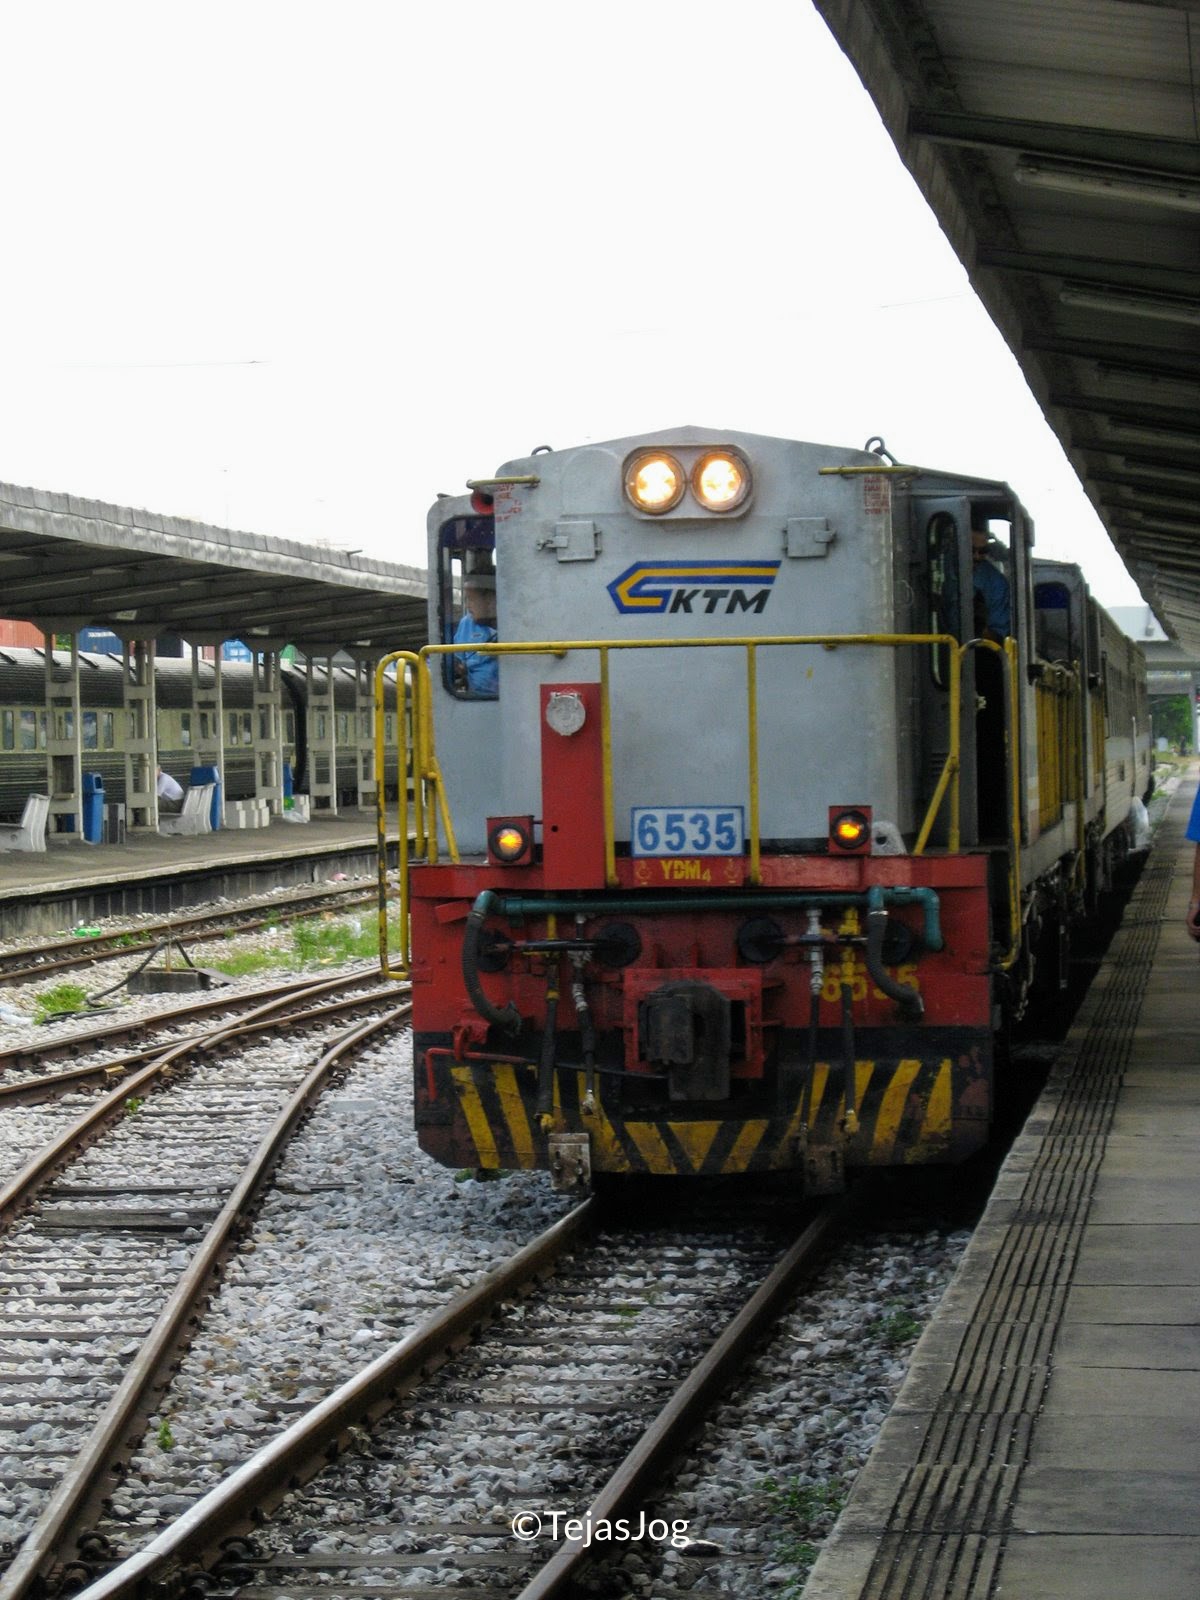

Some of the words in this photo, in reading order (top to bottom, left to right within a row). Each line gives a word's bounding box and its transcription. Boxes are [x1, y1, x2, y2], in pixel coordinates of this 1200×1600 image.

[669, 588, 772, 614] KTM
[637, 813, 737, 851] 6535
[821, 962, 919, 1002] 655
